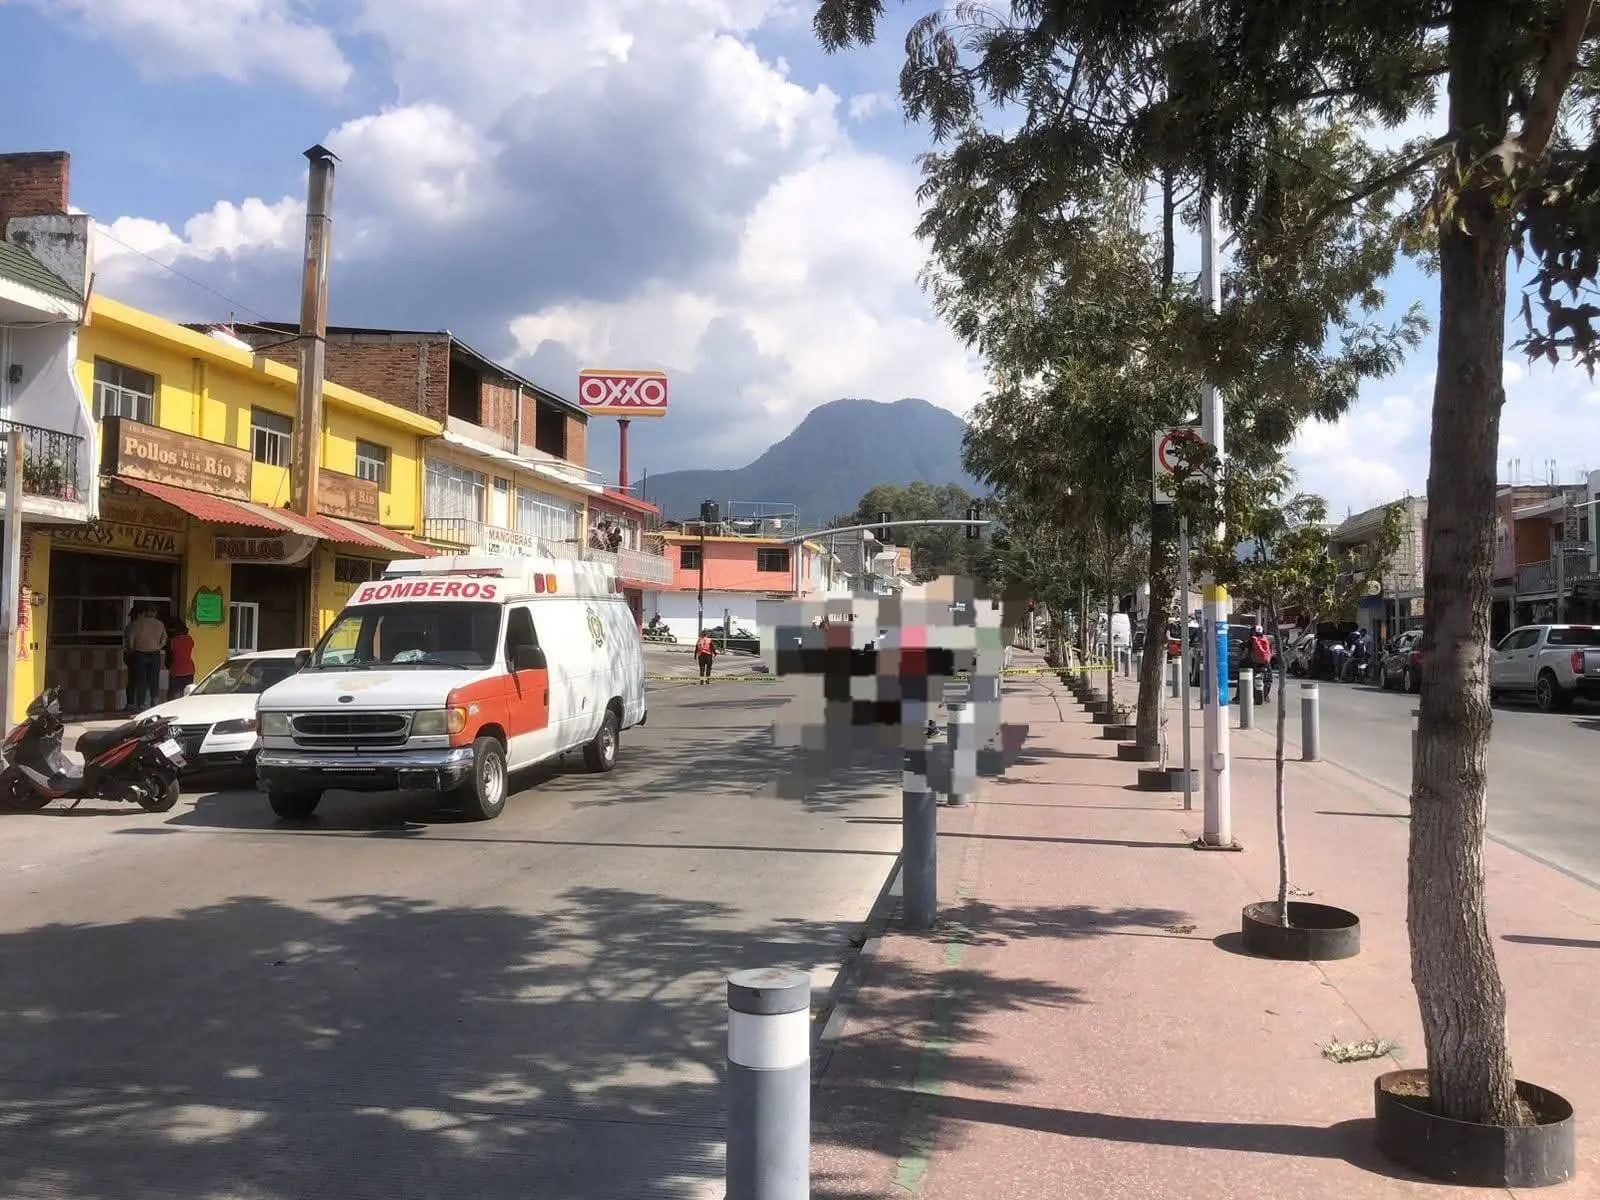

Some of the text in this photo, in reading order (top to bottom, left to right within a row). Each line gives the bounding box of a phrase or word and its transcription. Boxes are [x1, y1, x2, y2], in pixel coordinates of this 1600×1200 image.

[581, 377, 666, 406] OXXO
[124, 437, 232, 478] Pollos Río
[488, 529, 533, 548] MANGUERAS
[215, 539, 286, 560] POLLOS
[359, 581, 497, 602] BOMBEROS
